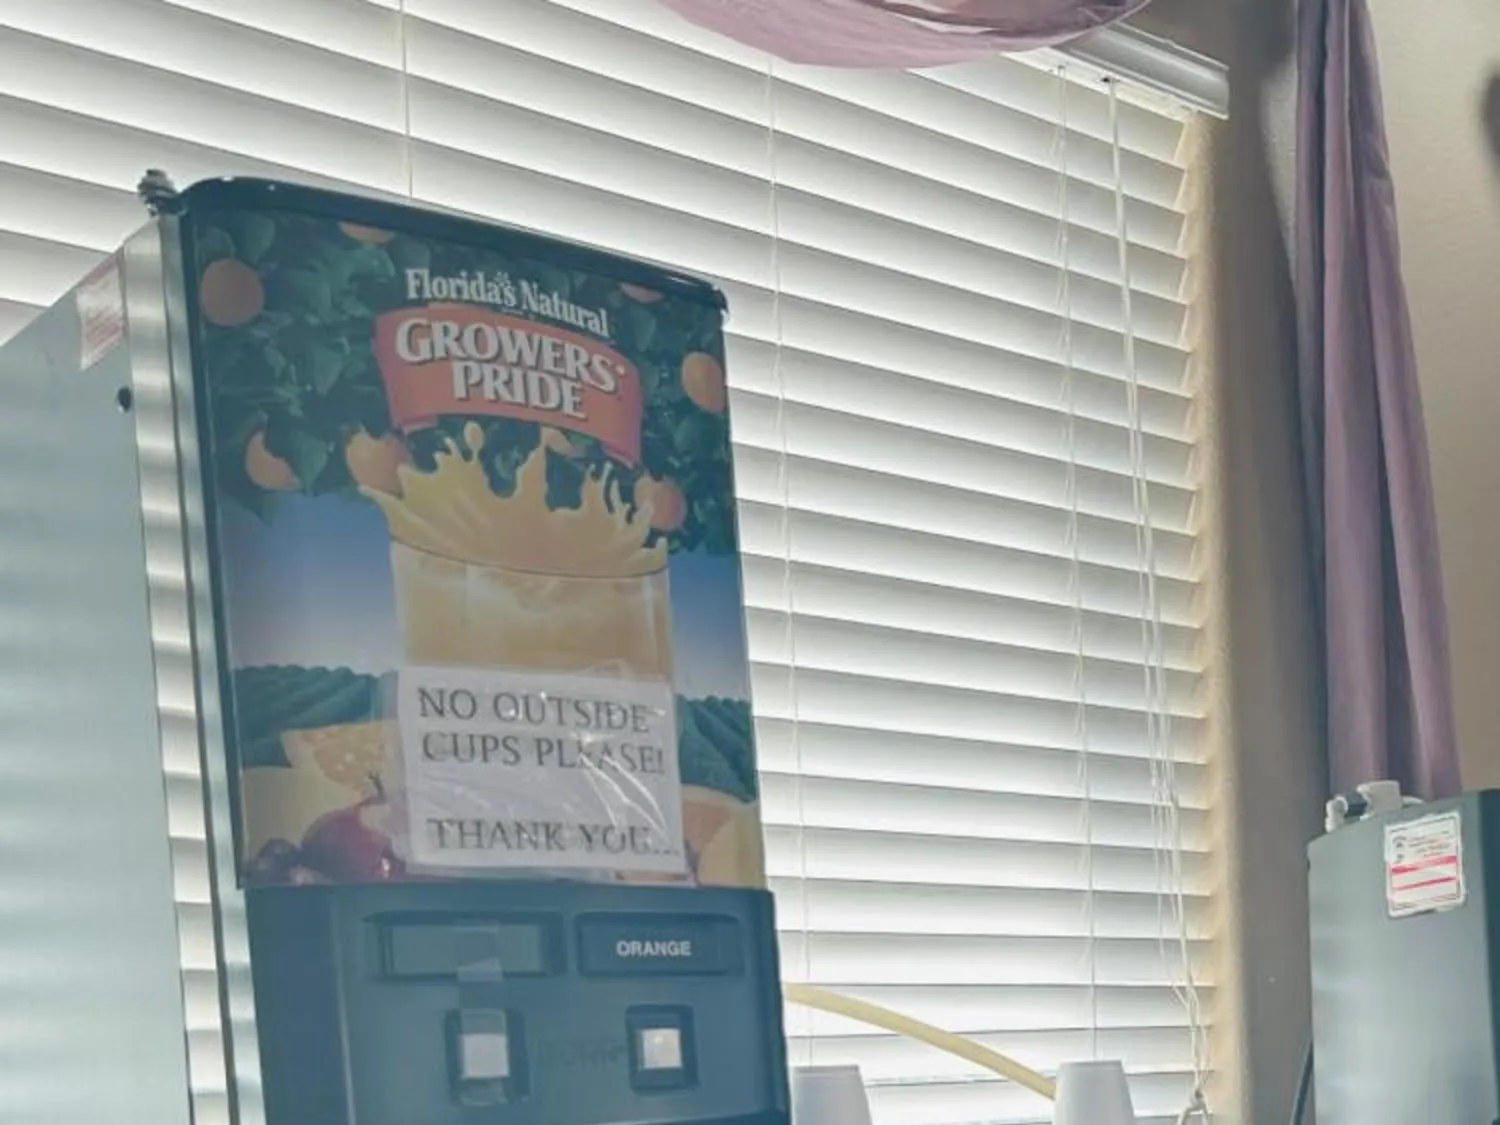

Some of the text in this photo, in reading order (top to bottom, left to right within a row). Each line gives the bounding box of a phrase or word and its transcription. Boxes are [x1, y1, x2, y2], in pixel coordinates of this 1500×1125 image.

[405, 268, 609, 337] Florida's Natural
[452, 360, 588, 419] PRIDE
[417, 686, 650, 733] NO OUTSIDE
[422, 731, 521, 766] CUPS
[426, 817, 566, 851] THANK
[616, 941, 692, 958] ORANGE
